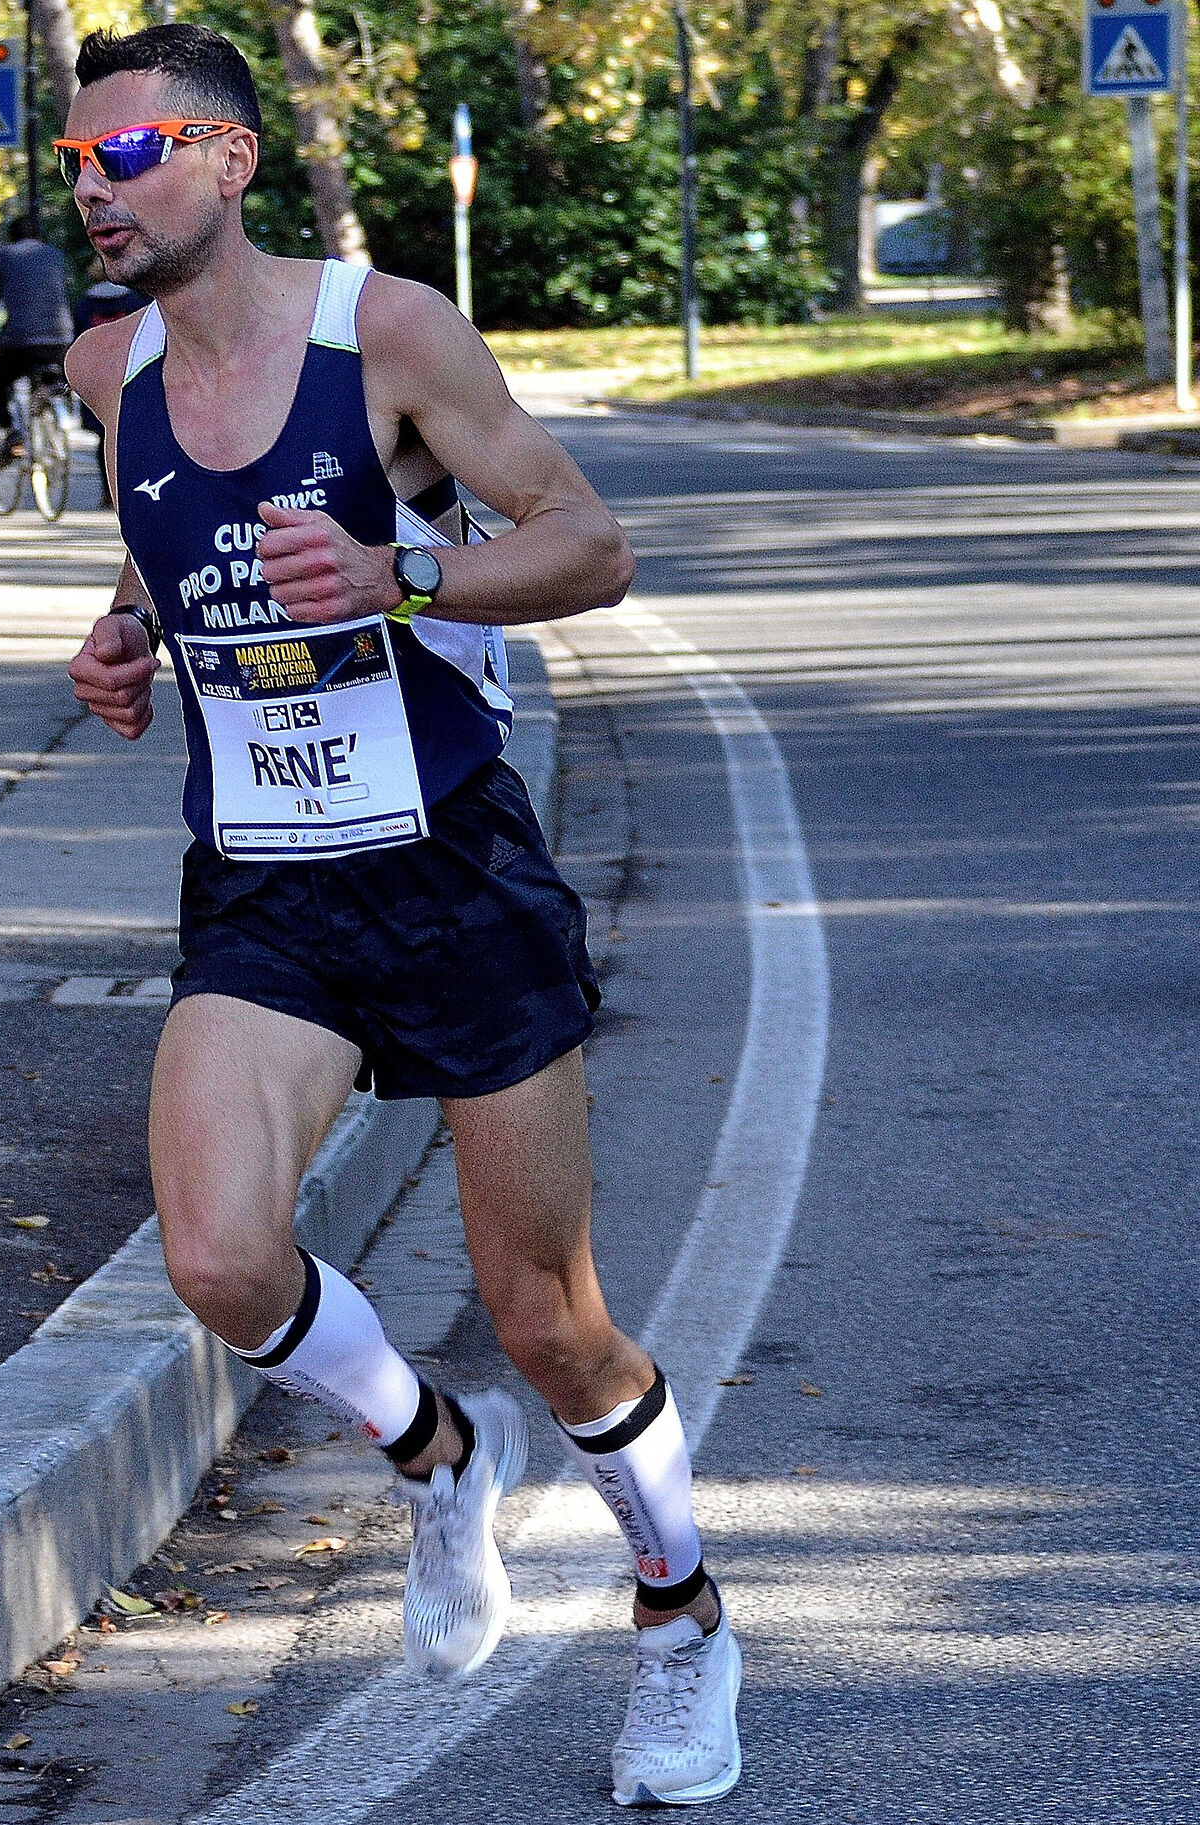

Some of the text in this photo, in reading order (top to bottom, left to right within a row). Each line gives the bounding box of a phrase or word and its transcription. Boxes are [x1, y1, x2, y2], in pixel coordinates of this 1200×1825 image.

[179, 565, 222, 609] PRO
[235, 641, 312, 666] MARATONA
[257, 659, 317, 678] DI RAVENNA
[489, 845, 525, 872] adidas
